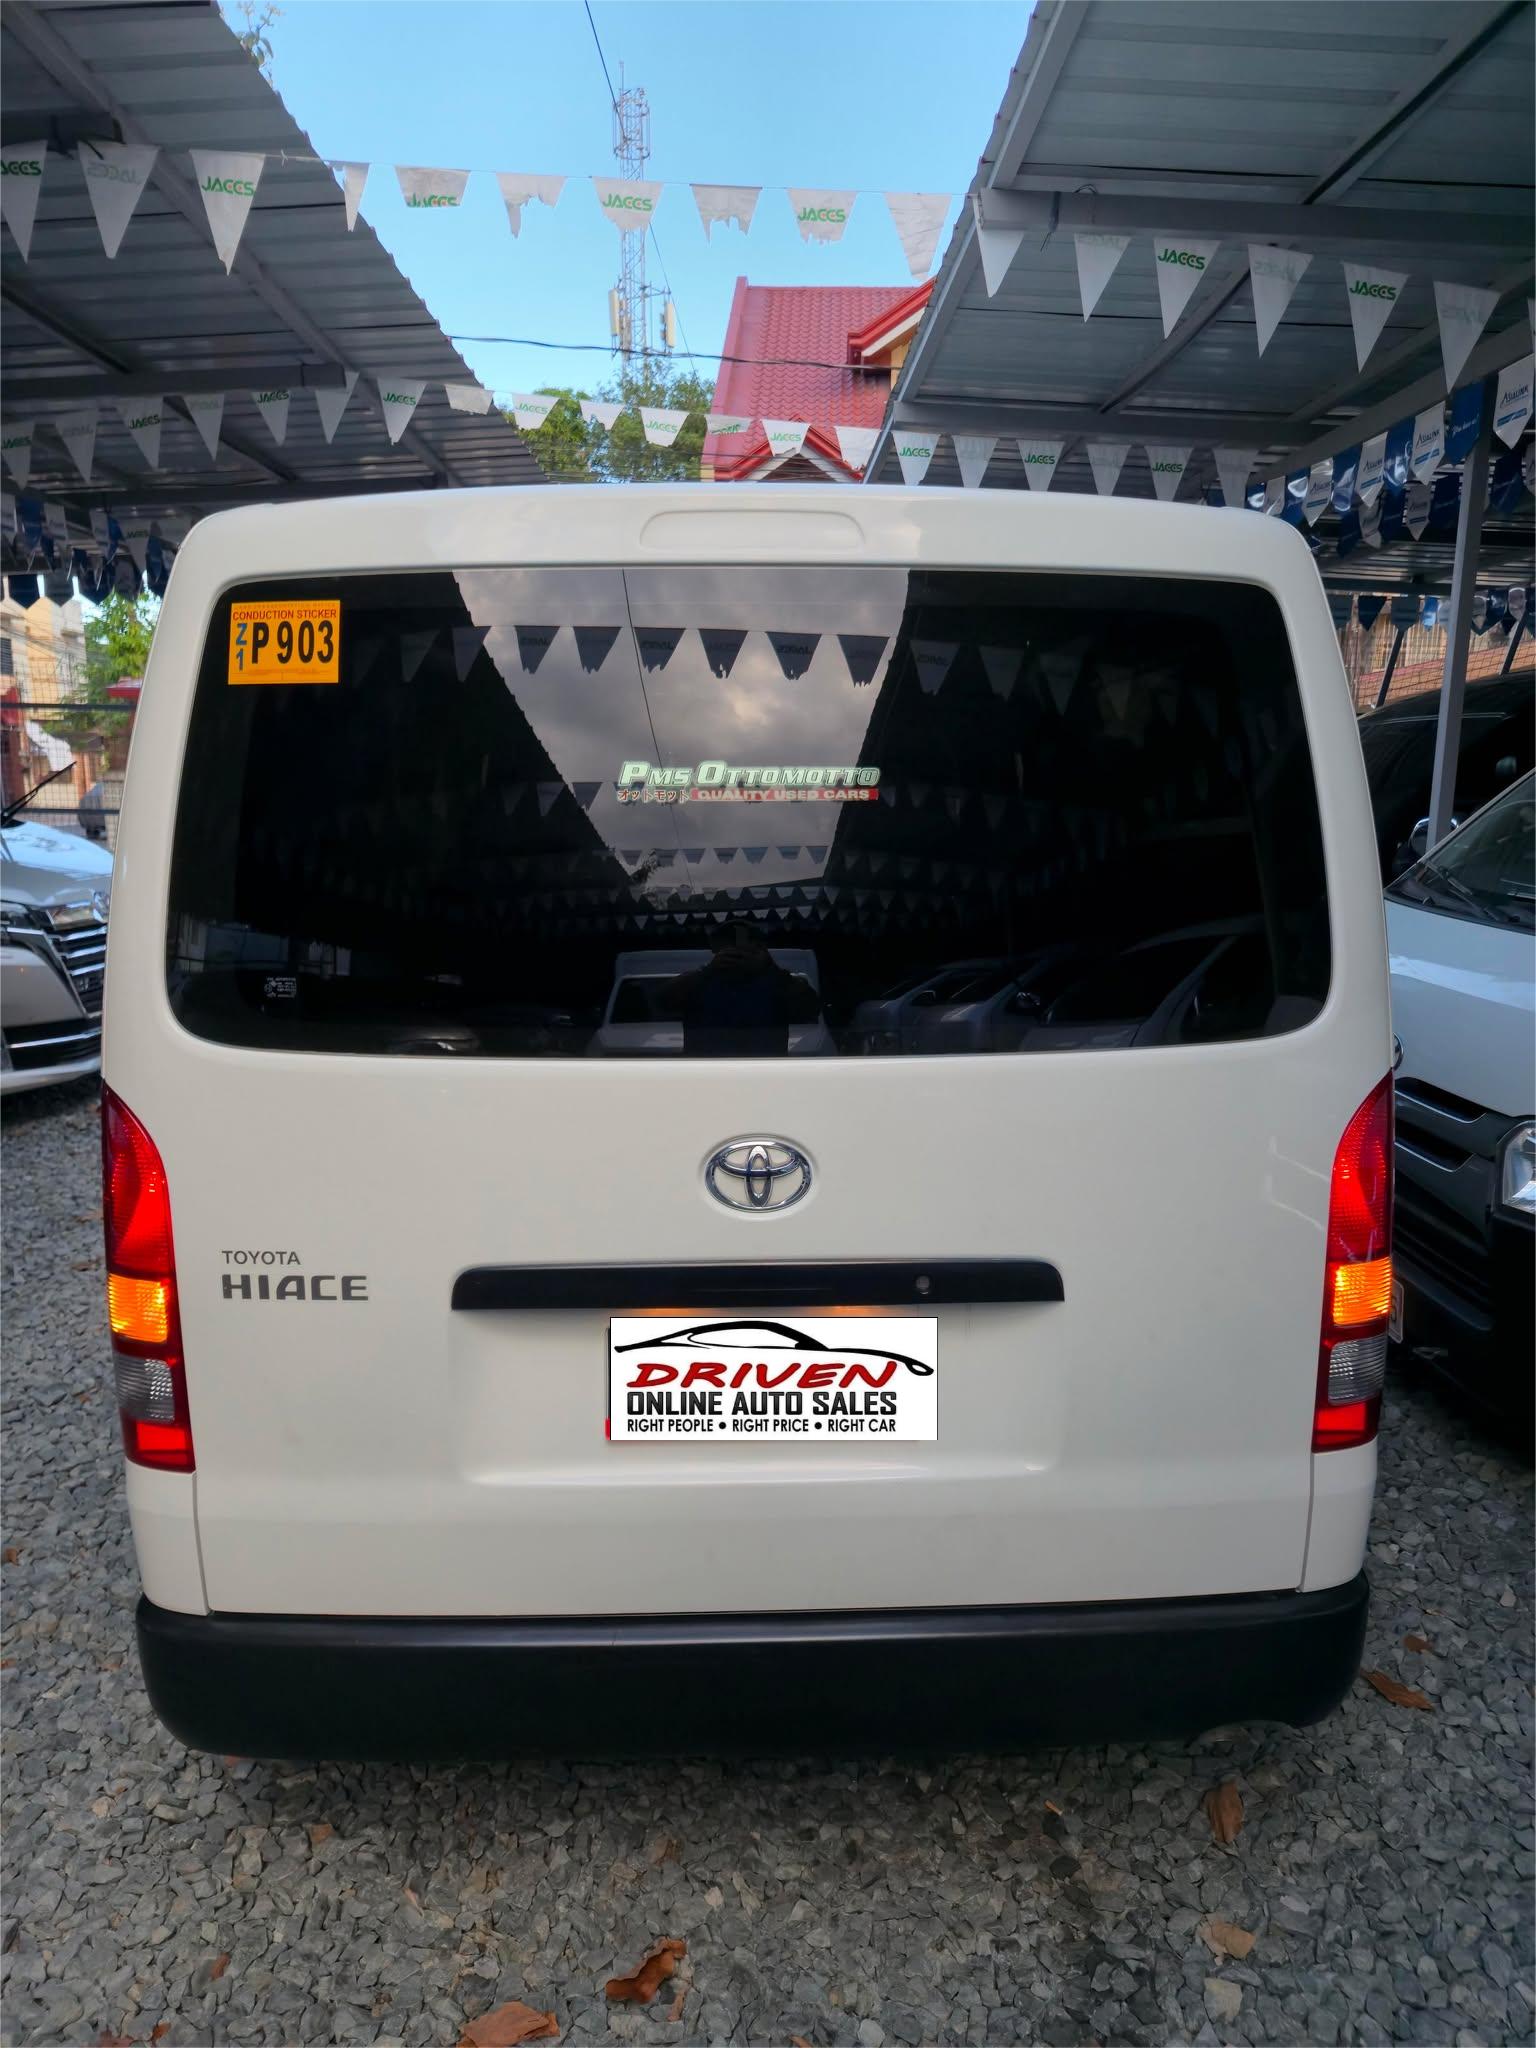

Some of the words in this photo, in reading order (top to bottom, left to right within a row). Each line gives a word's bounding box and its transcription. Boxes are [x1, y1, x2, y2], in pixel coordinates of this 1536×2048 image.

[0, 160, 42, 176] ACCS
[201, 176, 255, 196] JACCS
[602, 193, 652, 211] JACCS
[798, 207, 846, 223] JACCS
[1157, 248, 1206, 270] JACCS
[1349, 280, 1397, 300] JACCS
[256, 391, 289, 404] JACCS
[382, 392, 417, 406] JACCS
[518, 403, 548, 415] JACCS
[646, 420, 678, 434] JACCS
[770, 432, 802, 442] JACCS
[899, 447, 931, 458] JACCS
[1023, 454, 1056, 465] JACCS
[1151, 462, 1183, 473] JACCS
[232, 609, 294, 621] CONDUCTION
[296, 608, 337, 620] STICKER
[251, 619, 334, 665] P903
[617, 788, 691, 804] オットモット
[696, 789, 770, 801] QUALITY
[774, 789, 819, 801] USED
[823, 789, 870, 801] CARS
[221, 1250, 301, 1266] TOYOTA
[221, 1274, 369, 1301] HIACE
